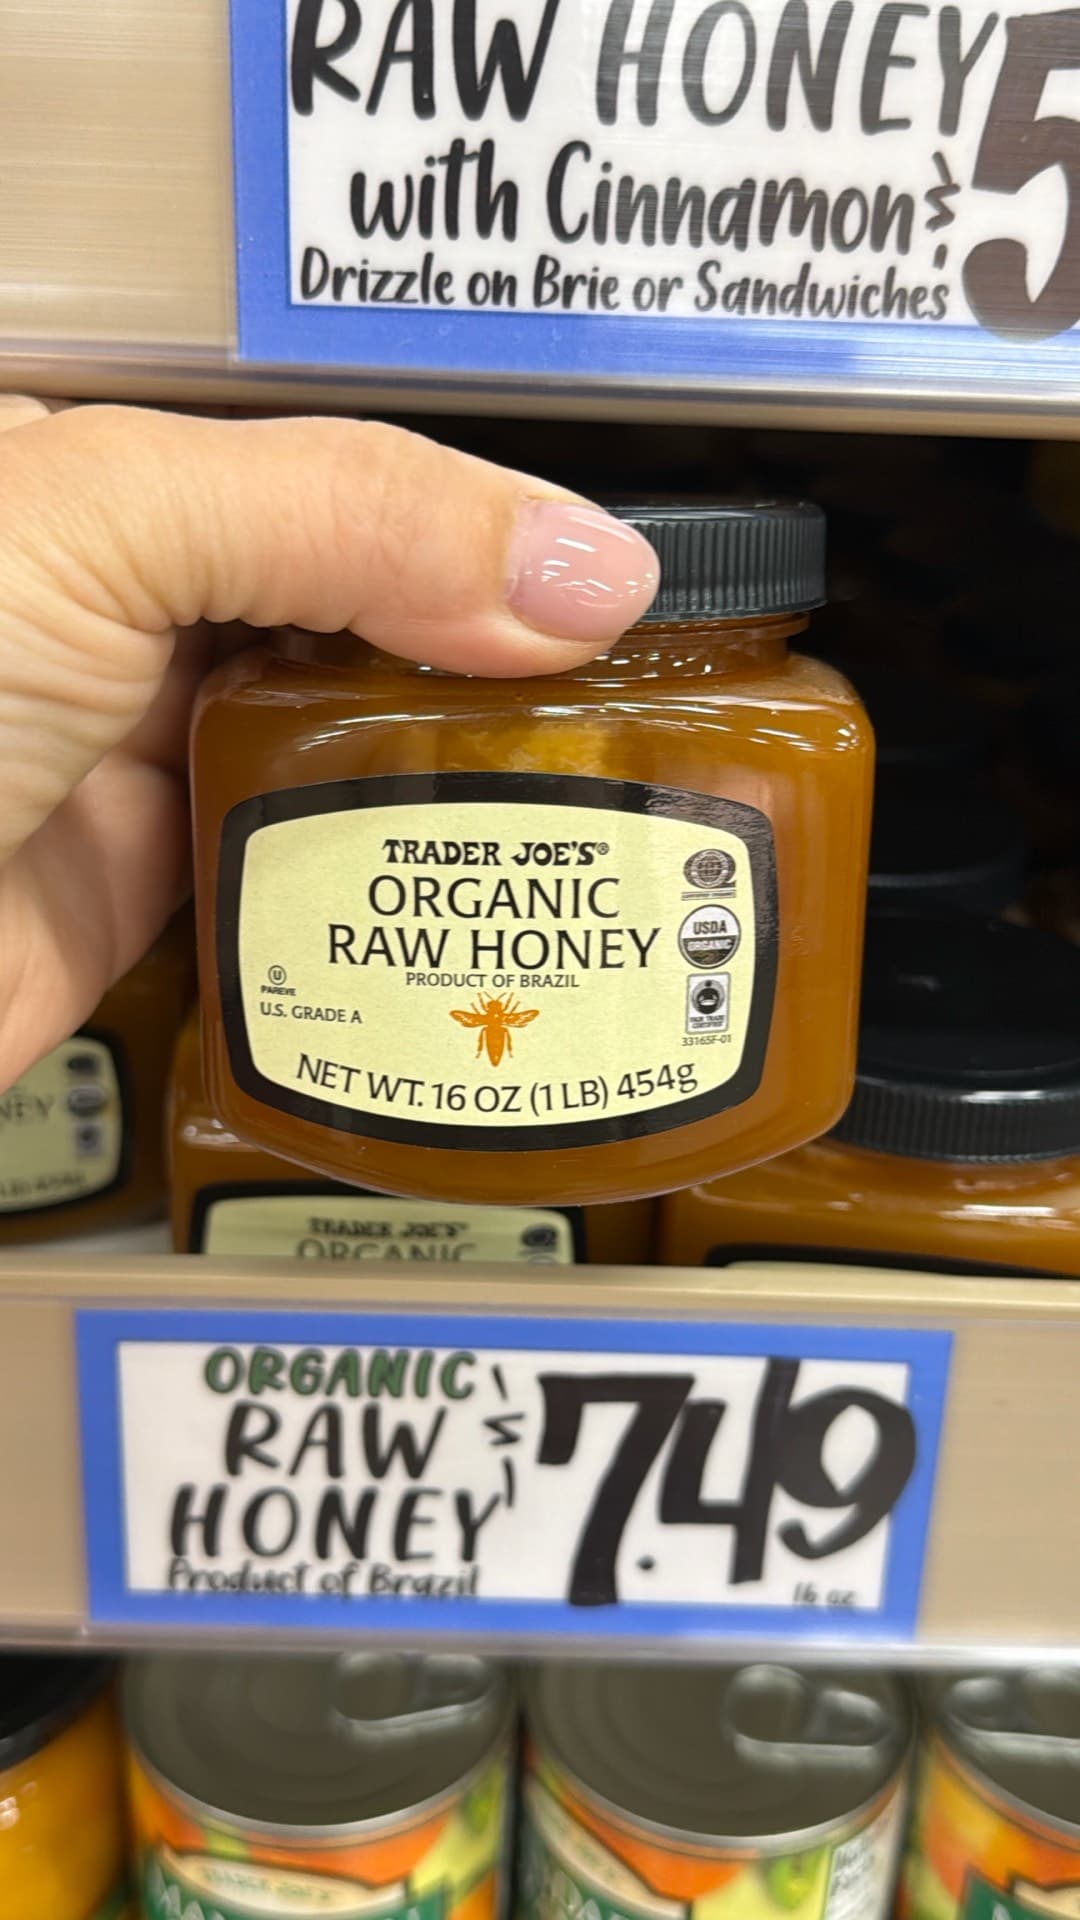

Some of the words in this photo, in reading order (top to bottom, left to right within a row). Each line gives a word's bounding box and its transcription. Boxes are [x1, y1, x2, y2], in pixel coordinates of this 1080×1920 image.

[290, 0, 557, 122] RAW
[595, 0, 1000, 135] HONEY
[349, 138, 519, 242] with
[546, 140, 915, 255] Cinnamon
[300, 246, 455, 306] Drizzle
[467, 261, 517, 305] on
[533, 254, 620, 311] Brie
[631, 272, 684, 313] or
[693, 261, 949, 322] Sandwiches
[382, 839, 501, 866] TRADER
[368, 875, 620, 919] ORGANIC
[328, 924, 449, 967] RAW
[470, 928, 661, 970] HONEY
[693, 920, 728, 935] USDA
[405, 971, 487, 987] PRODUCT
[491, 973, 515, 988] OF
[520, 972, 580, 988] BRAZIL
[260, 1002, 288, 1018] U.S.
[291, 1005, 347, 1023] GRADE
[350, 1010, 363, 1024] A
[296, 1053, 361, 1092] NET
[367, 1072, 424, 1107] WT.
[431, 1082, 466, 1110] 16
[474, 1085, 521, 1113] OZ
[559, 1076, 609, 1111] LB)
[617, 1061, 699, 1101] 454g
[203, 1347, 477, 1399] ORGANIC
[224, 1401, 447, 1479] RAW
[537, 1356, 917, 1606] 7.49
[171, 1483, 504, 1563] HONEY
[168, 1555, 308, 1594] Product
[319, 1562, 360, 1600] of
[368, 1562, 480, 1598] Brazil
